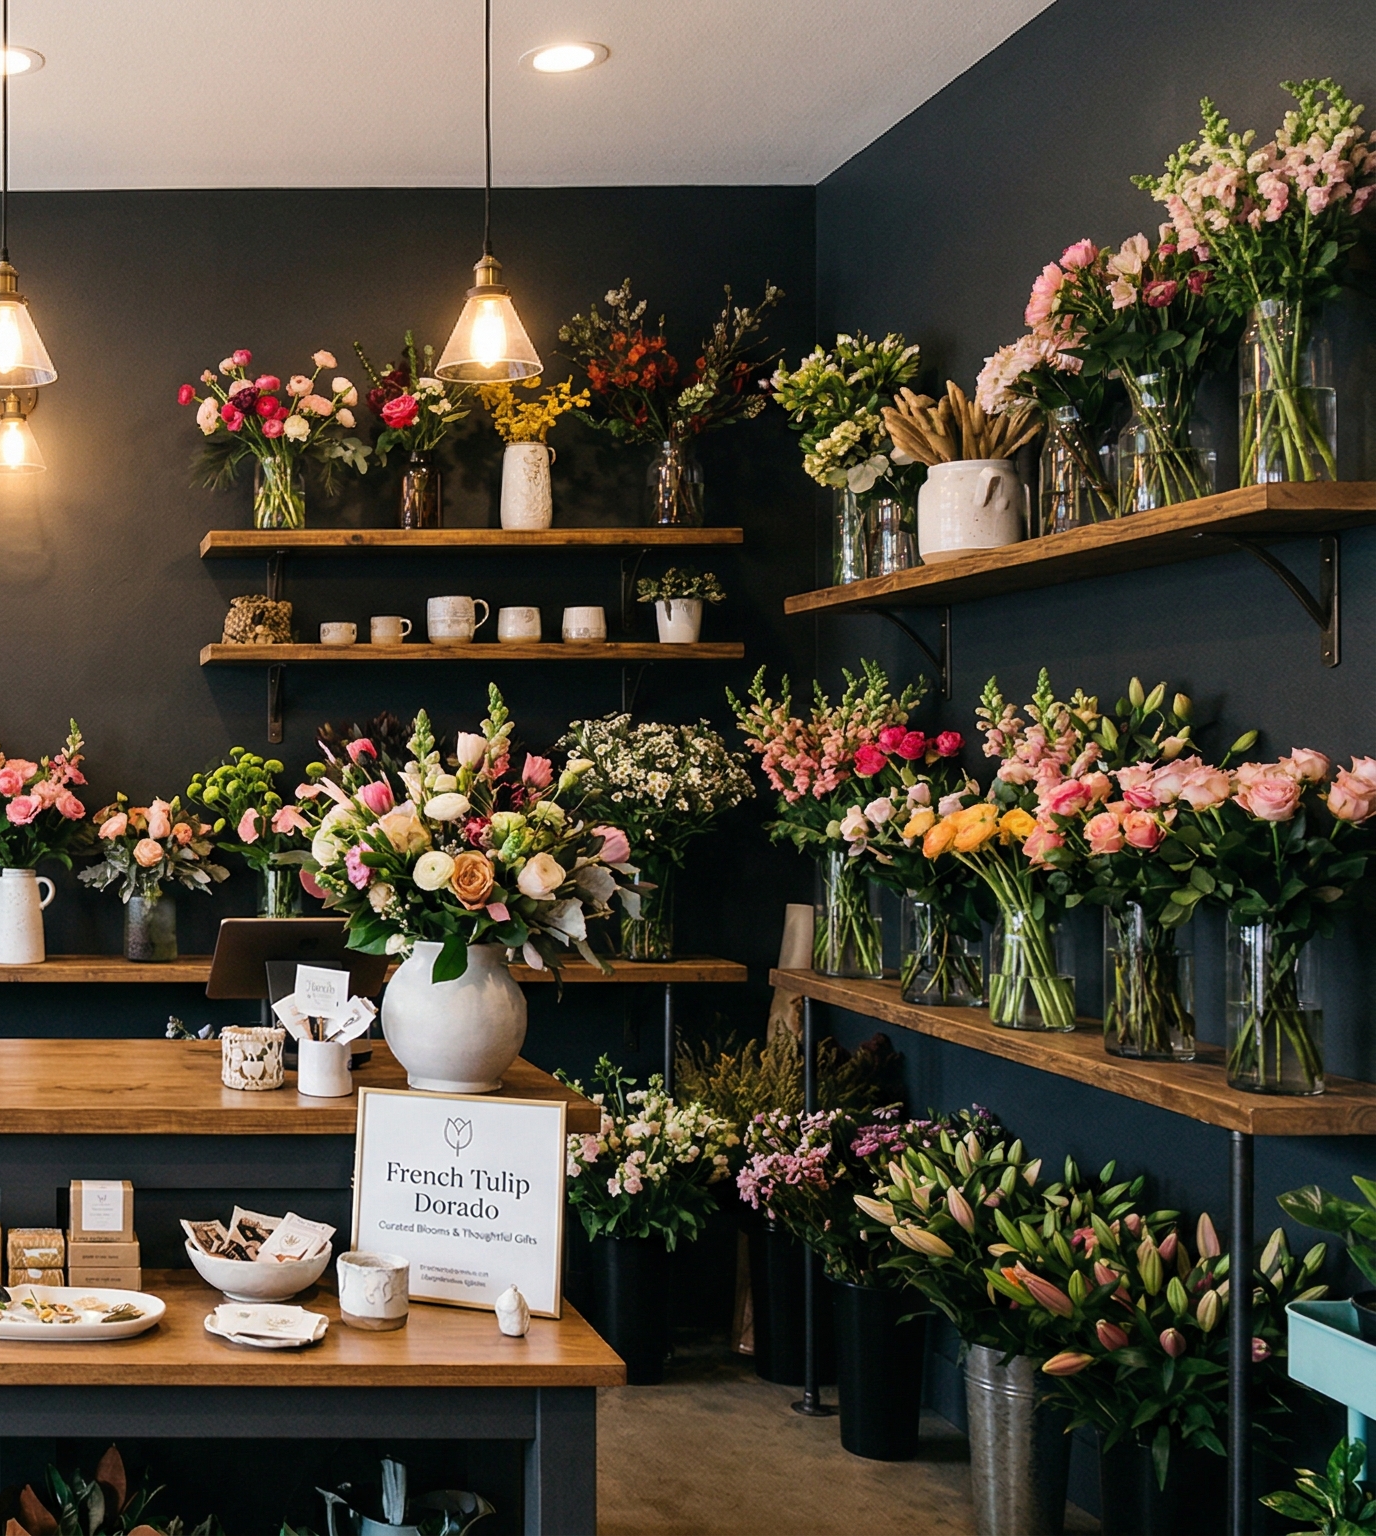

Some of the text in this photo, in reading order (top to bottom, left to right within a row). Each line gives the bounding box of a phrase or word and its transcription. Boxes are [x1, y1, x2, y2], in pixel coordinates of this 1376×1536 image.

[387, 1162, 530, 1200] French Tulip
[415, 1193, 499, 1220] Dorado
[378, 1220, 538, 1245] Curated Blooms & Thoughtful Gifts
